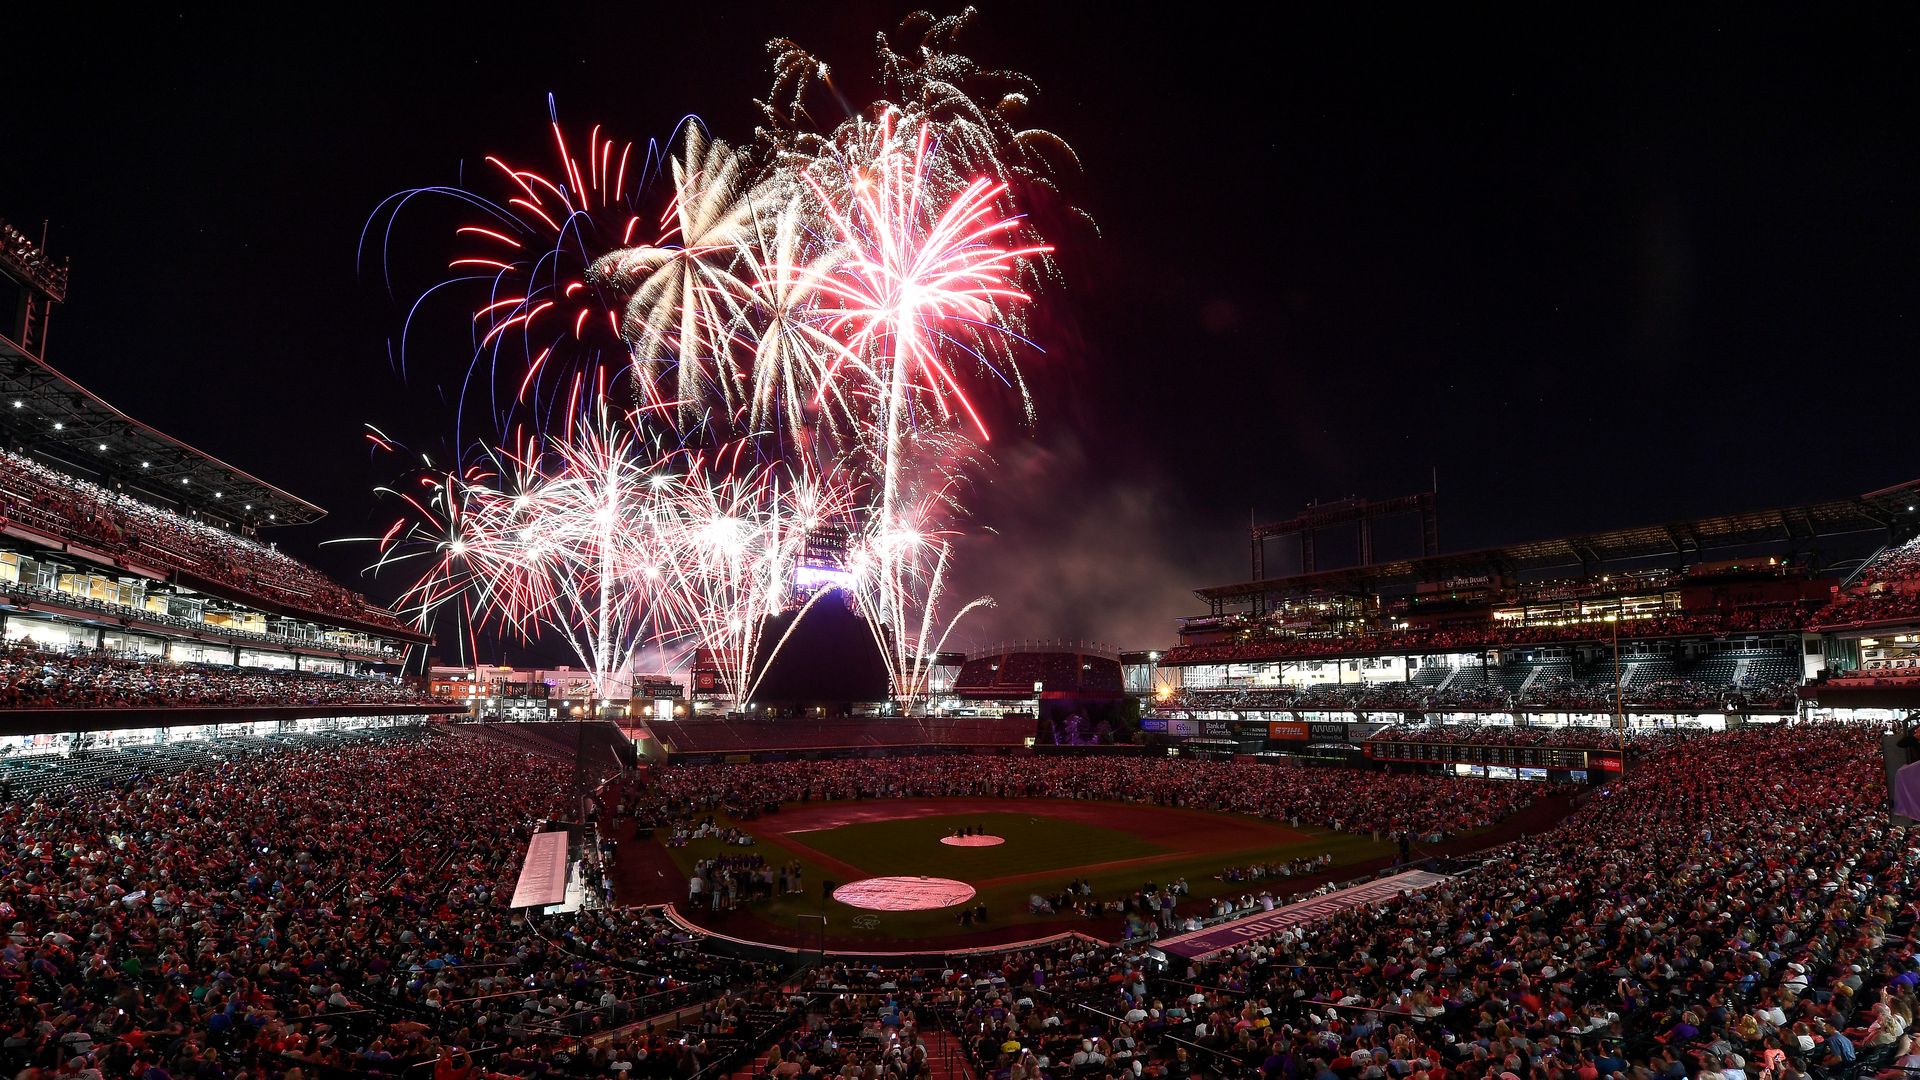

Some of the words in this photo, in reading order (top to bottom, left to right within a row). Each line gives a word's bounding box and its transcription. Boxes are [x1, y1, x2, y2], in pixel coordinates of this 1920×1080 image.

[714, 677, 739, 685] TOYOT
[1206, 728, 1232, 736] Colorado
[1274, 727, 1304, 736] STIHL
[1311, 724, 1343, 733] ARROW
[1231, 902, 1343, 937] COLORADO
[1340, 881, 1411, 905] ROCKIES
